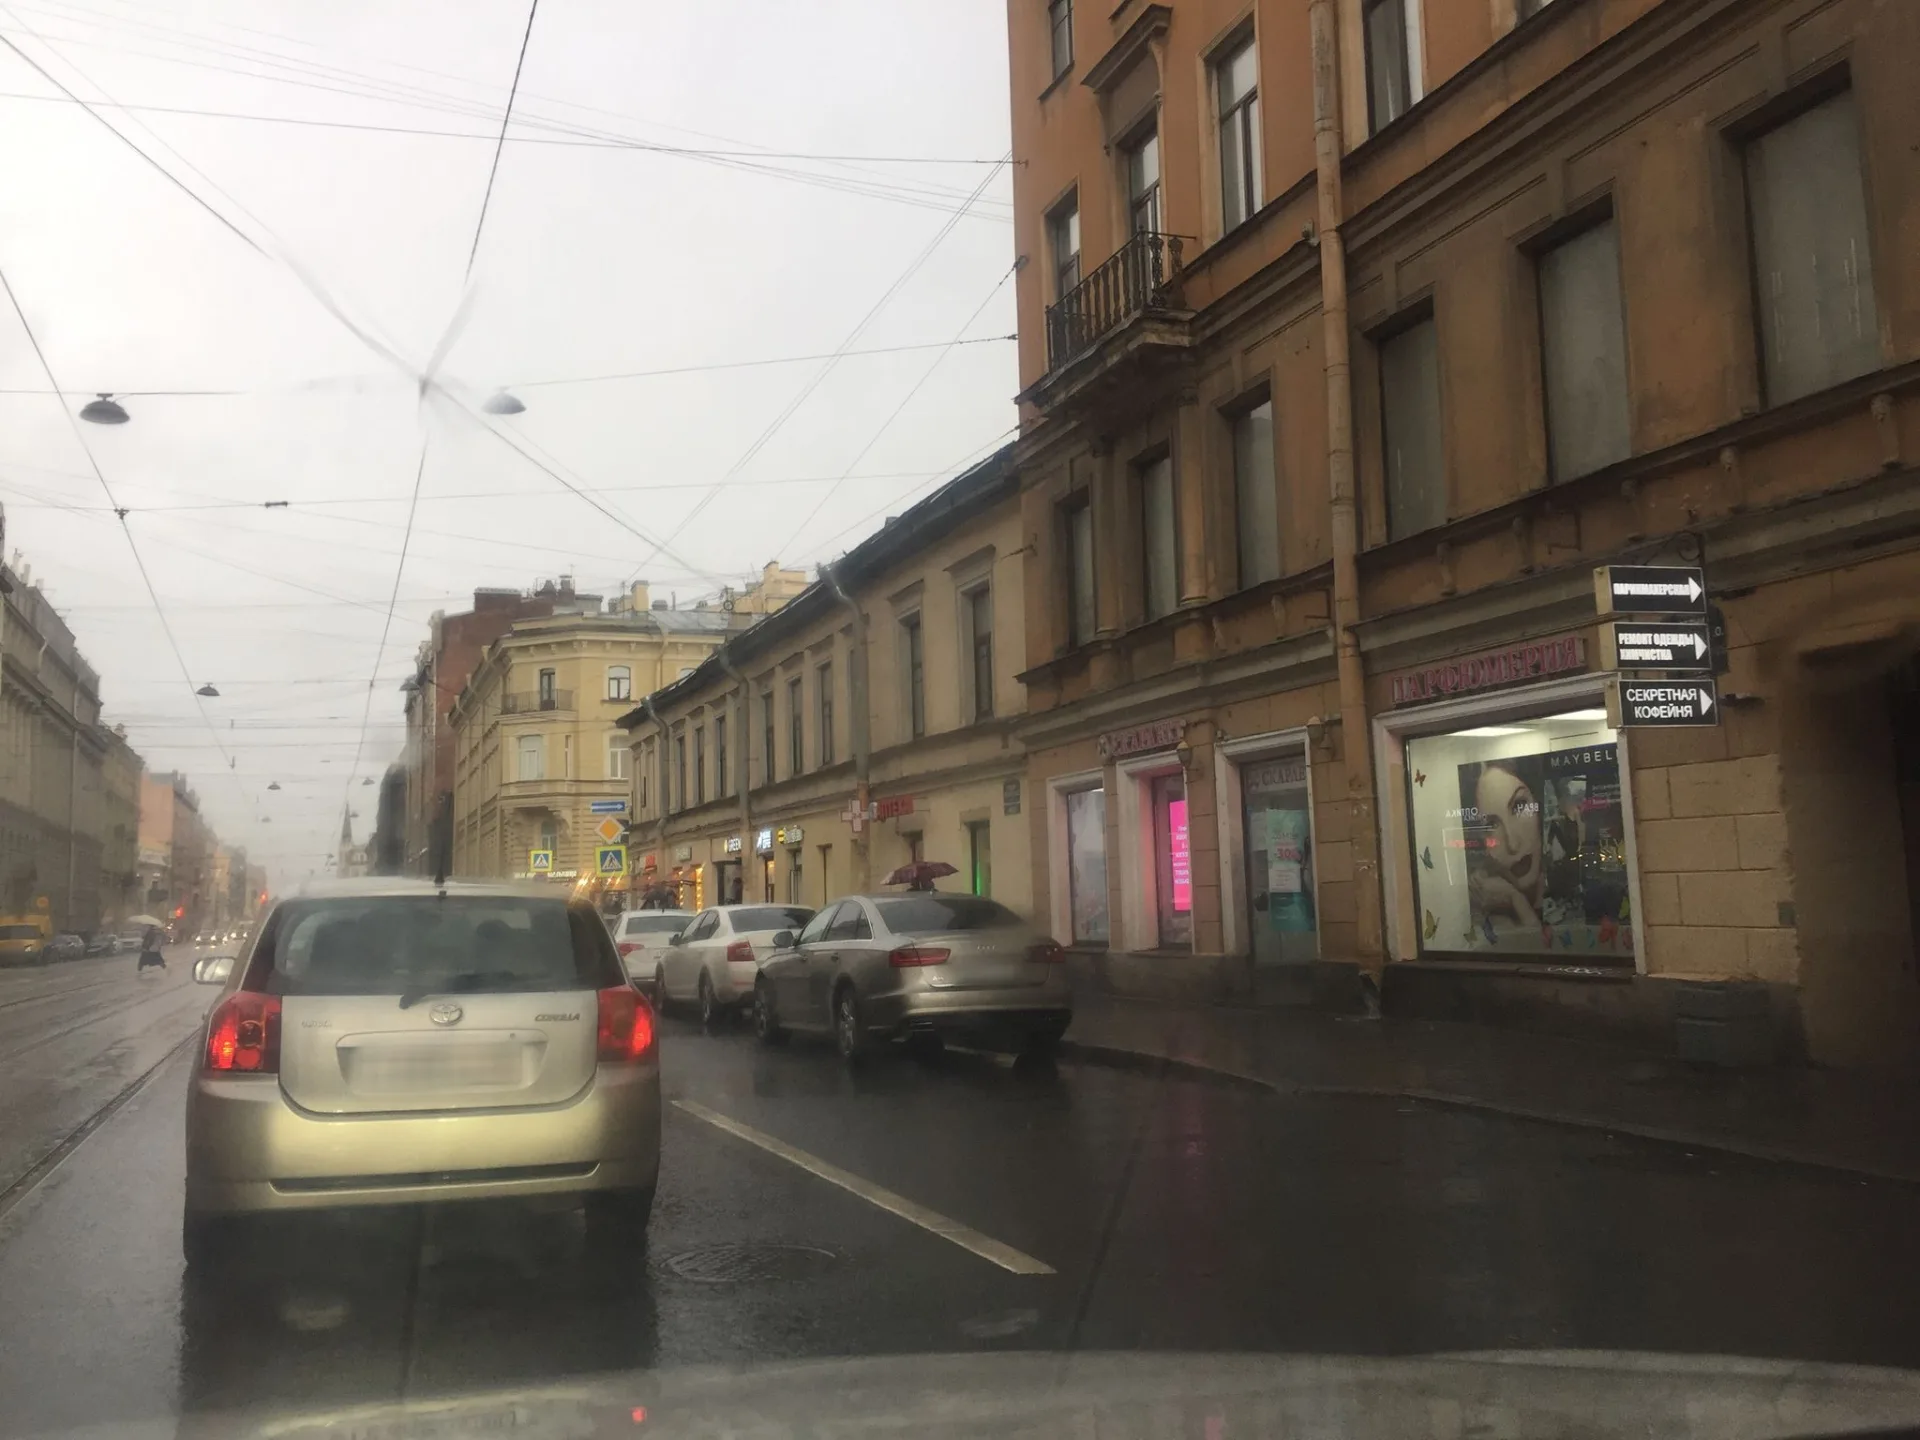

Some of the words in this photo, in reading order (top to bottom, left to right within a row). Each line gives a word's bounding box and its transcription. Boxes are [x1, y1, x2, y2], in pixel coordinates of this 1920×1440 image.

[1618, 633, 1652, 645] РЕМОНТ
[1653, 633, 1694, 646] ОДЕЖДЫ
[1391, 636, 1579, 702] ПАРФЮМЕРИЯ
[1626, 688, 1697, 702] СЕКРЕТНАЯ
[1634, 703, 1693, 718] КОФЕЙНЯ
[1550, 749, 1618, 767] MAYBEL
